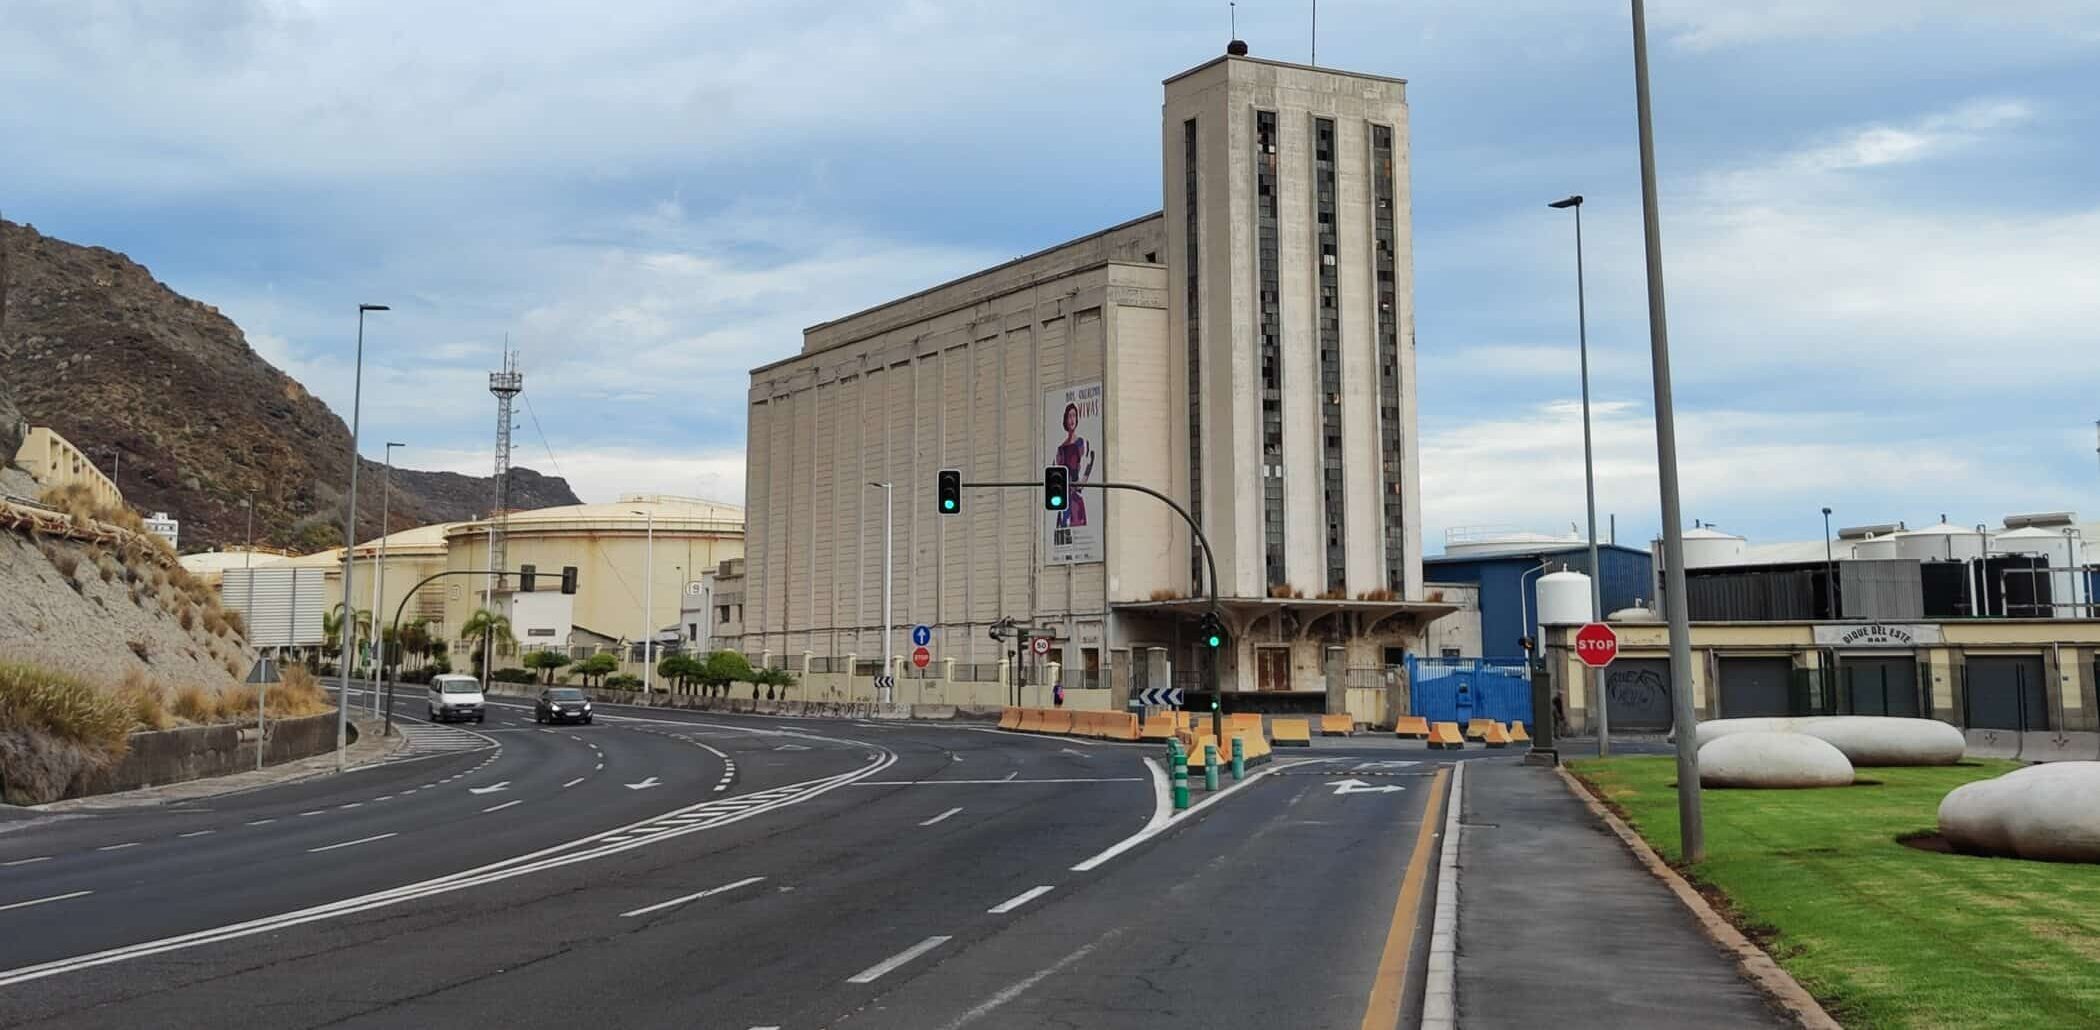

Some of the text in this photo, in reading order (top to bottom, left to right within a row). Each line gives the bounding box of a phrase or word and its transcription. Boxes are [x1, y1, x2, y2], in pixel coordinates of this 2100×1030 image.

[1078, 398, 1098, 418] VIVAS
[1842, 626, 1911, 644] DIQUE DEL ESTE
[1578, 640, 1614, 651] STOP
